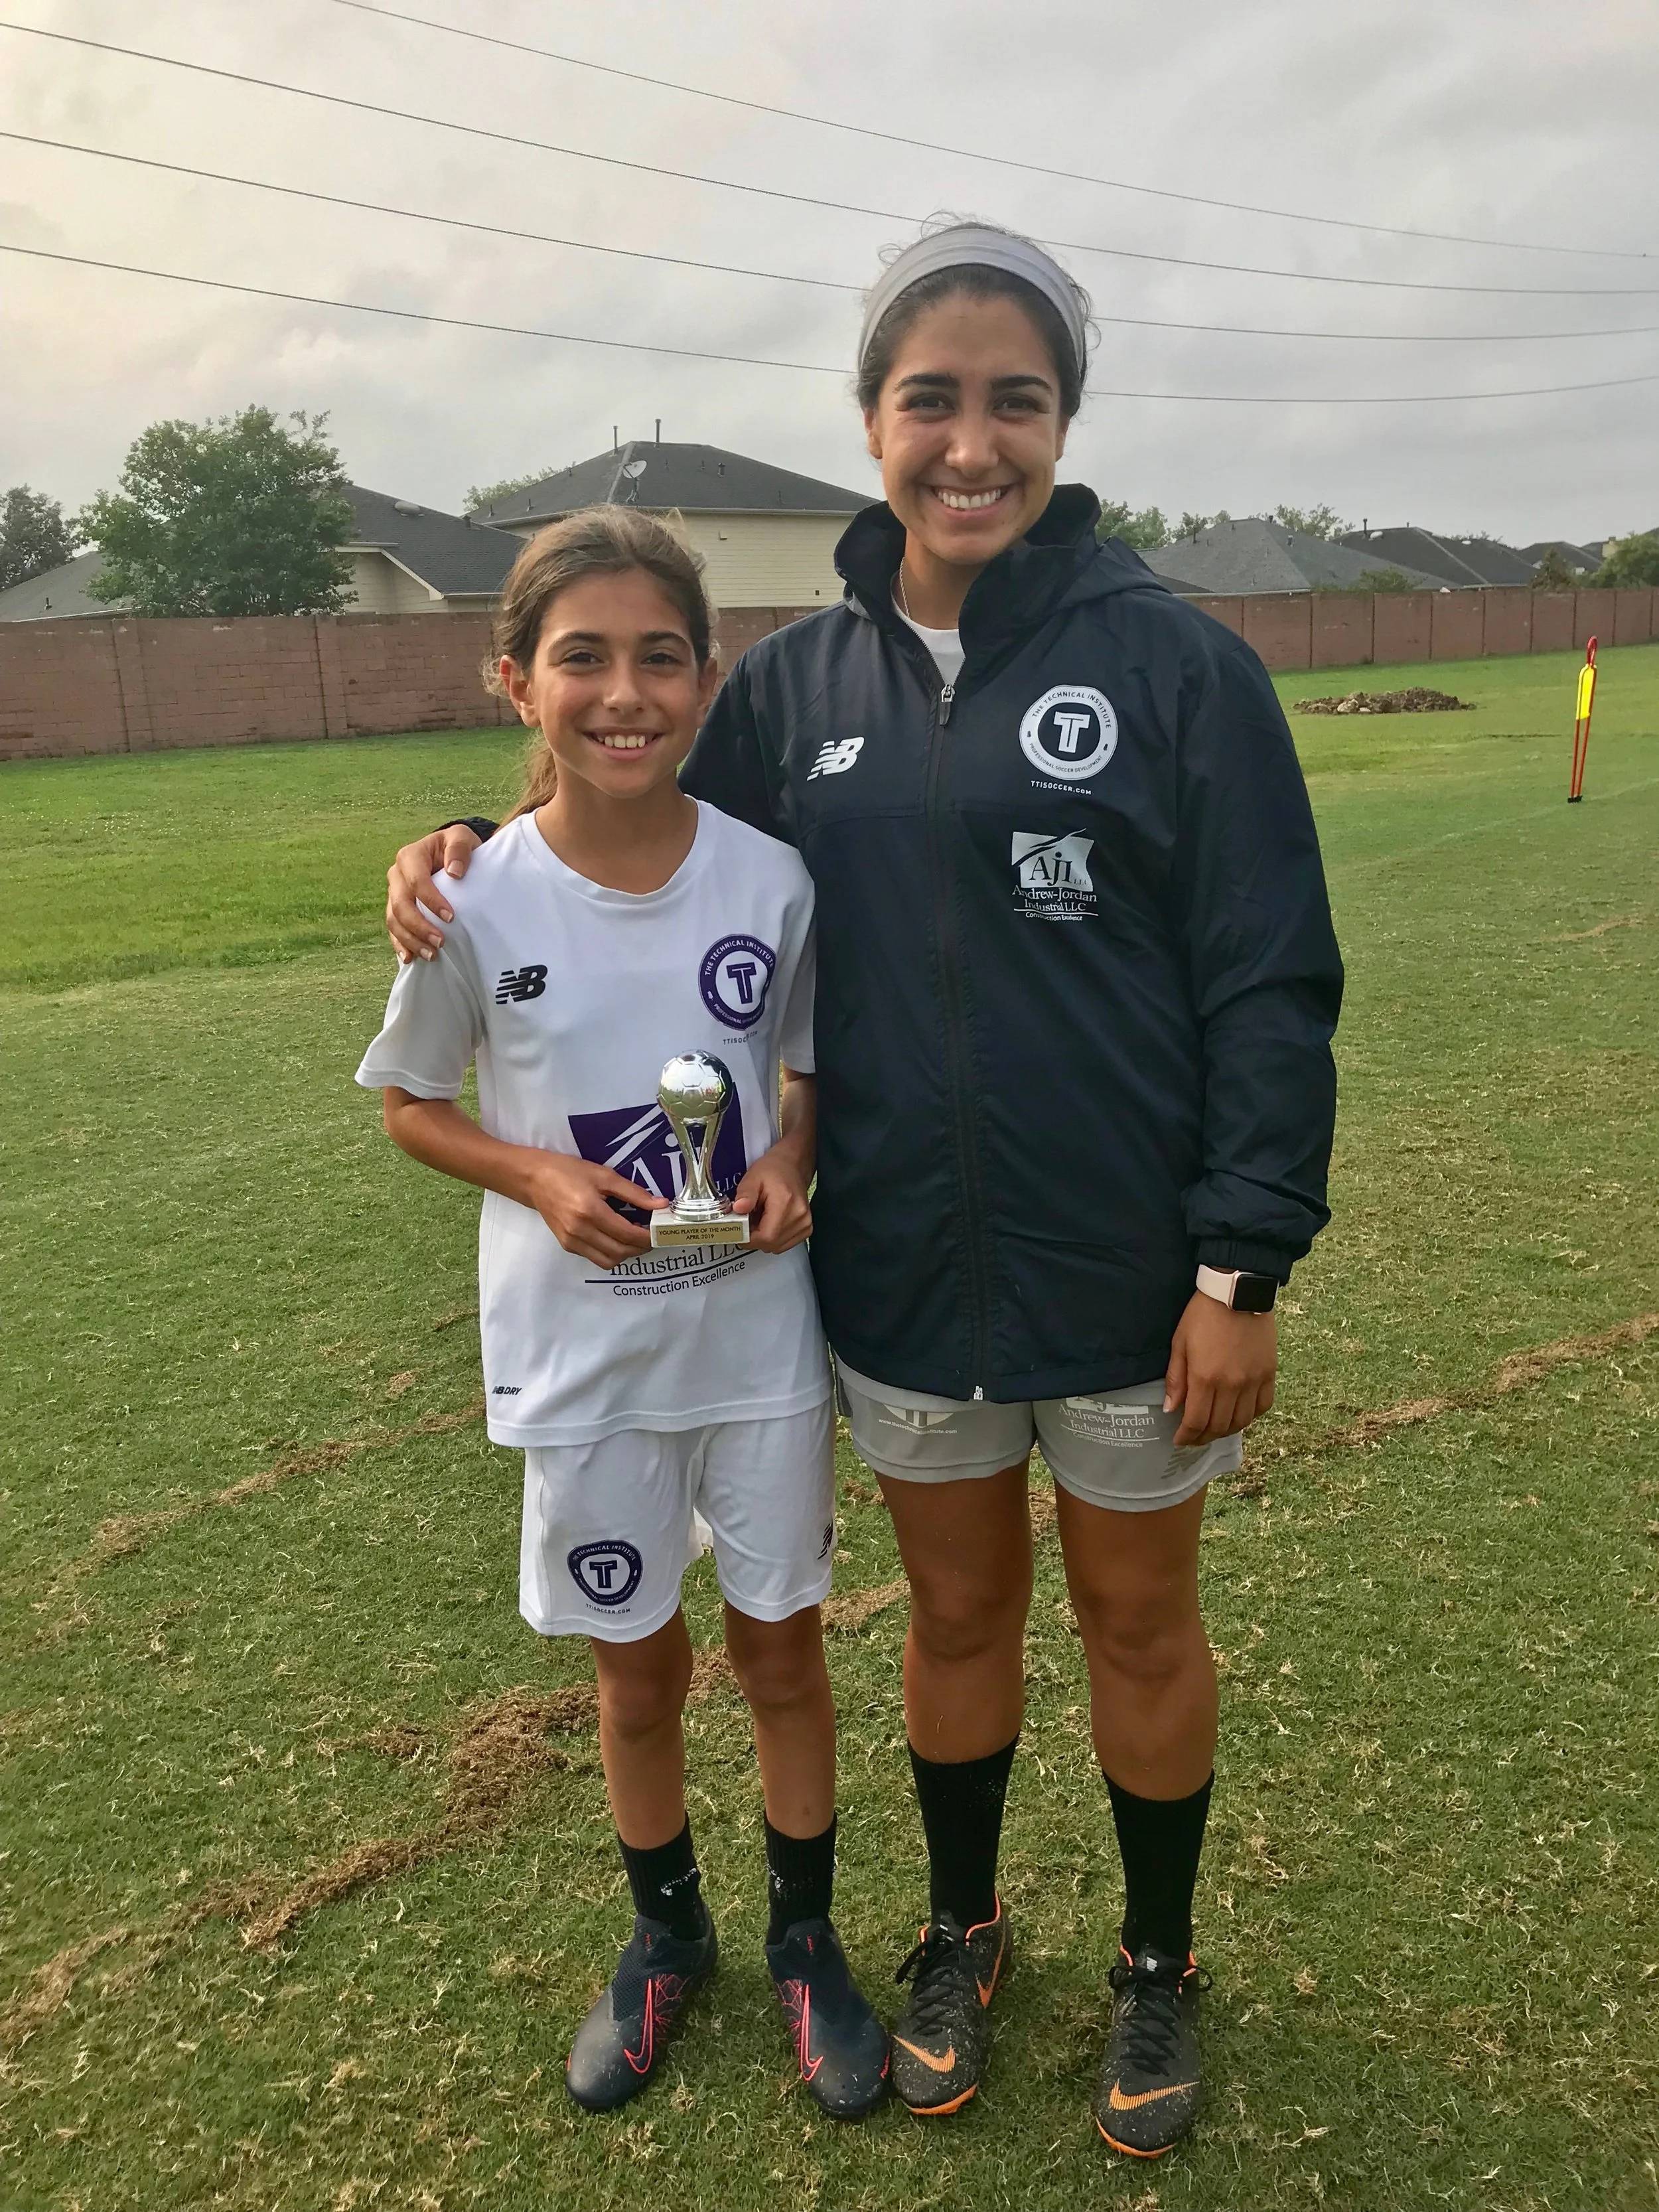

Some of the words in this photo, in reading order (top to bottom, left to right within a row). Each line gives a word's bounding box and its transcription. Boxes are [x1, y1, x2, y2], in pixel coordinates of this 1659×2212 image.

[1032, 704, 1044, 717] THE
[1044, 692, 1085, 704] TECHNICAL
[1087, 694, 1112, 729] INSTITUTE
[1031, 780, 1092, 795] TTISOCCER.COM
[1012, 885, 1097, 902] Andrew-Jordan
[1064, 903, 1086, 912] LLC
[704, 962, 713, 976] THE
[711, 940, 745, 961] TECHNICAL
[709, 1244, 743, 1262] LL
[613, 1280, 689, 1296] Construction
[692, 1262, 745, 1288] Excellence
[1058, 1404, 1155, 1427] Andrew-Jordan
[1070, 1420, 1117, 1438] Industrial
[1119, 1428, 1144, 1438] LLC
[1073, 1432, 1110, 1445] Construction
[577, 1545, 609, 1556] TECHNICAL
[611, 1545, 636, 1561] INSTITUTE
